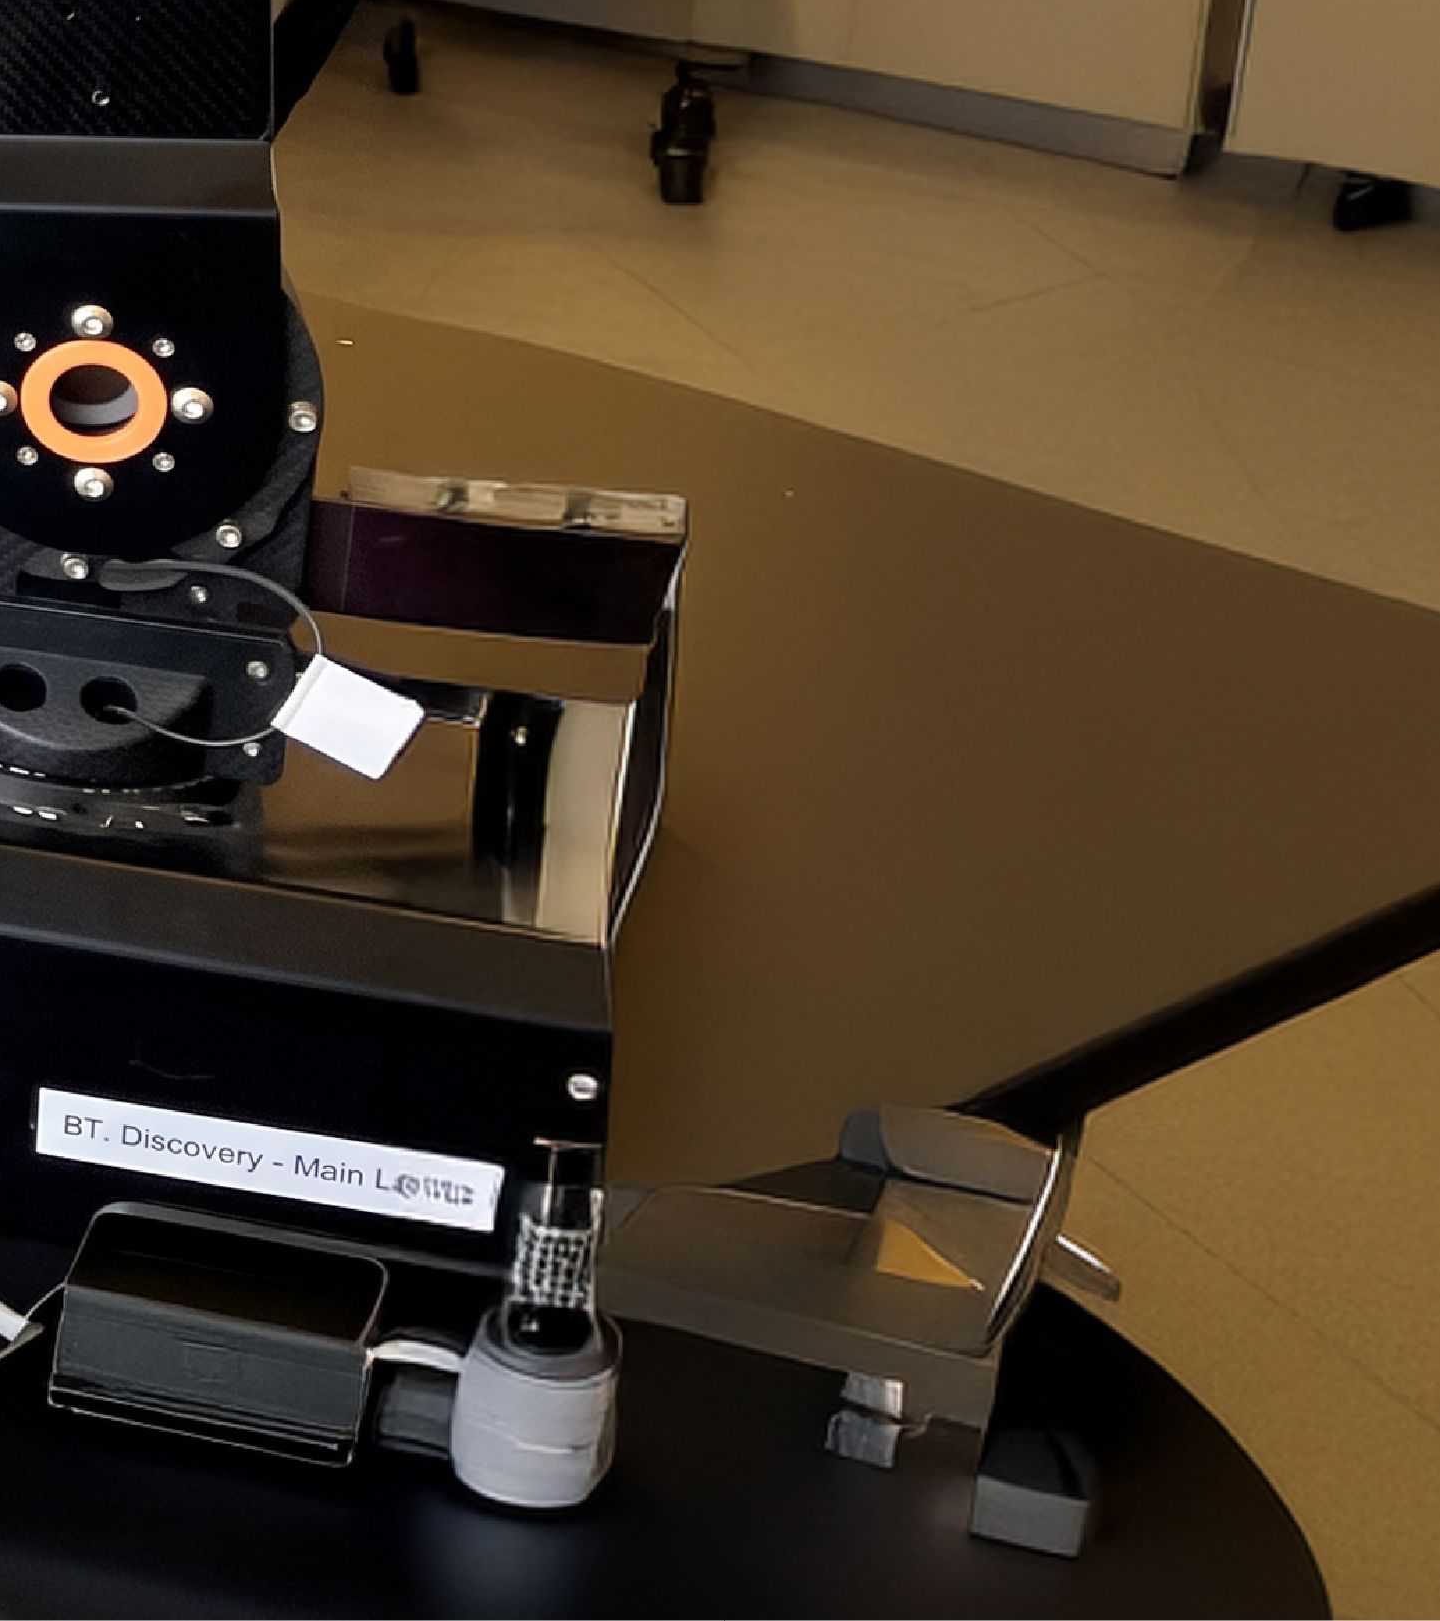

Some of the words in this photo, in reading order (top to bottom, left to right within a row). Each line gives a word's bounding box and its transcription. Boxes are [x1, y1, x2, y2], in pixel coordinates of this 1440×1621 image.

[63, 1115, 110, 1142] BT.
[121, 1126, 264, 1172] Discovery
[294, 1155, 363, 1187] Main
